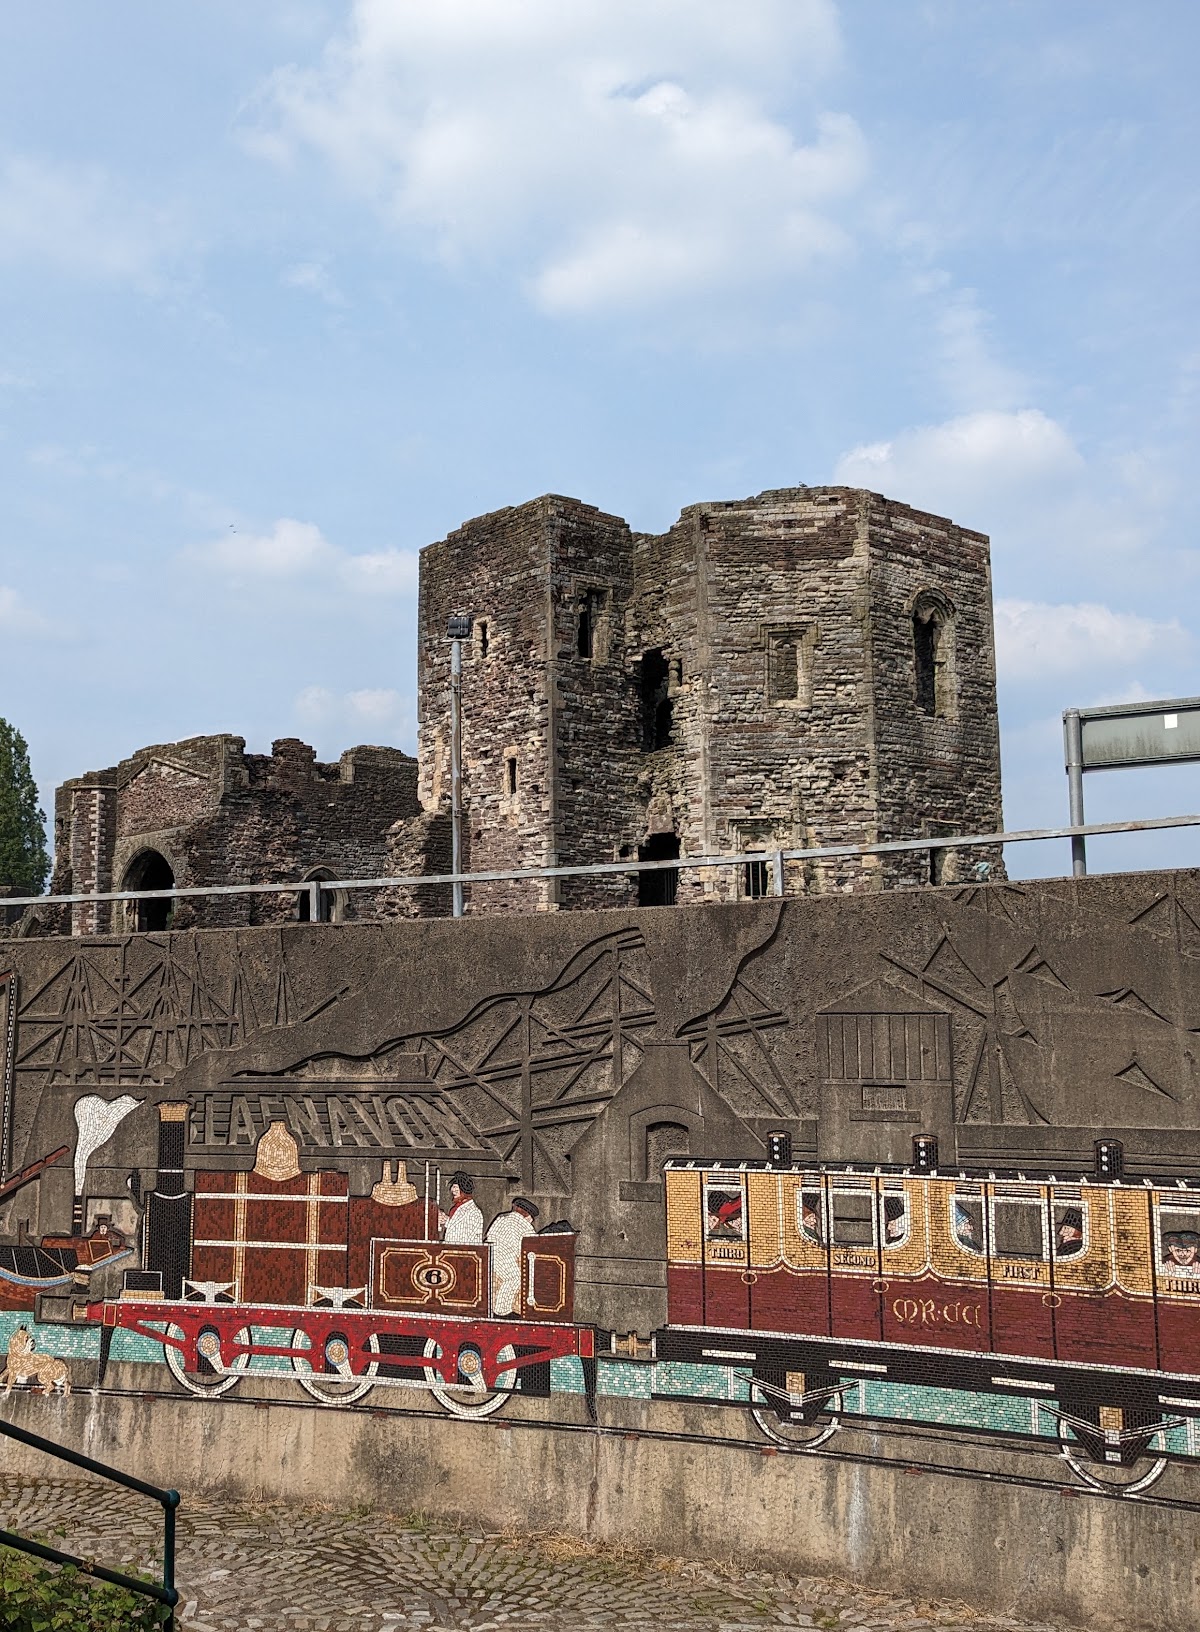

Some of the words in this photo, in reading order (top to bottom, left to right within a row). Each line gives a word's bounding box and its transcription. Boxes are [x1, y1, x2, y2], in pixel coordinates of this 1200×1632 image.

[708, 1247, 745, 1260] THIRD
[834, 1253, 876, 1267] SECOND
[425, 1269, 442, 1285] 6
[1003, 1265, 1040, 1280] FIRST
